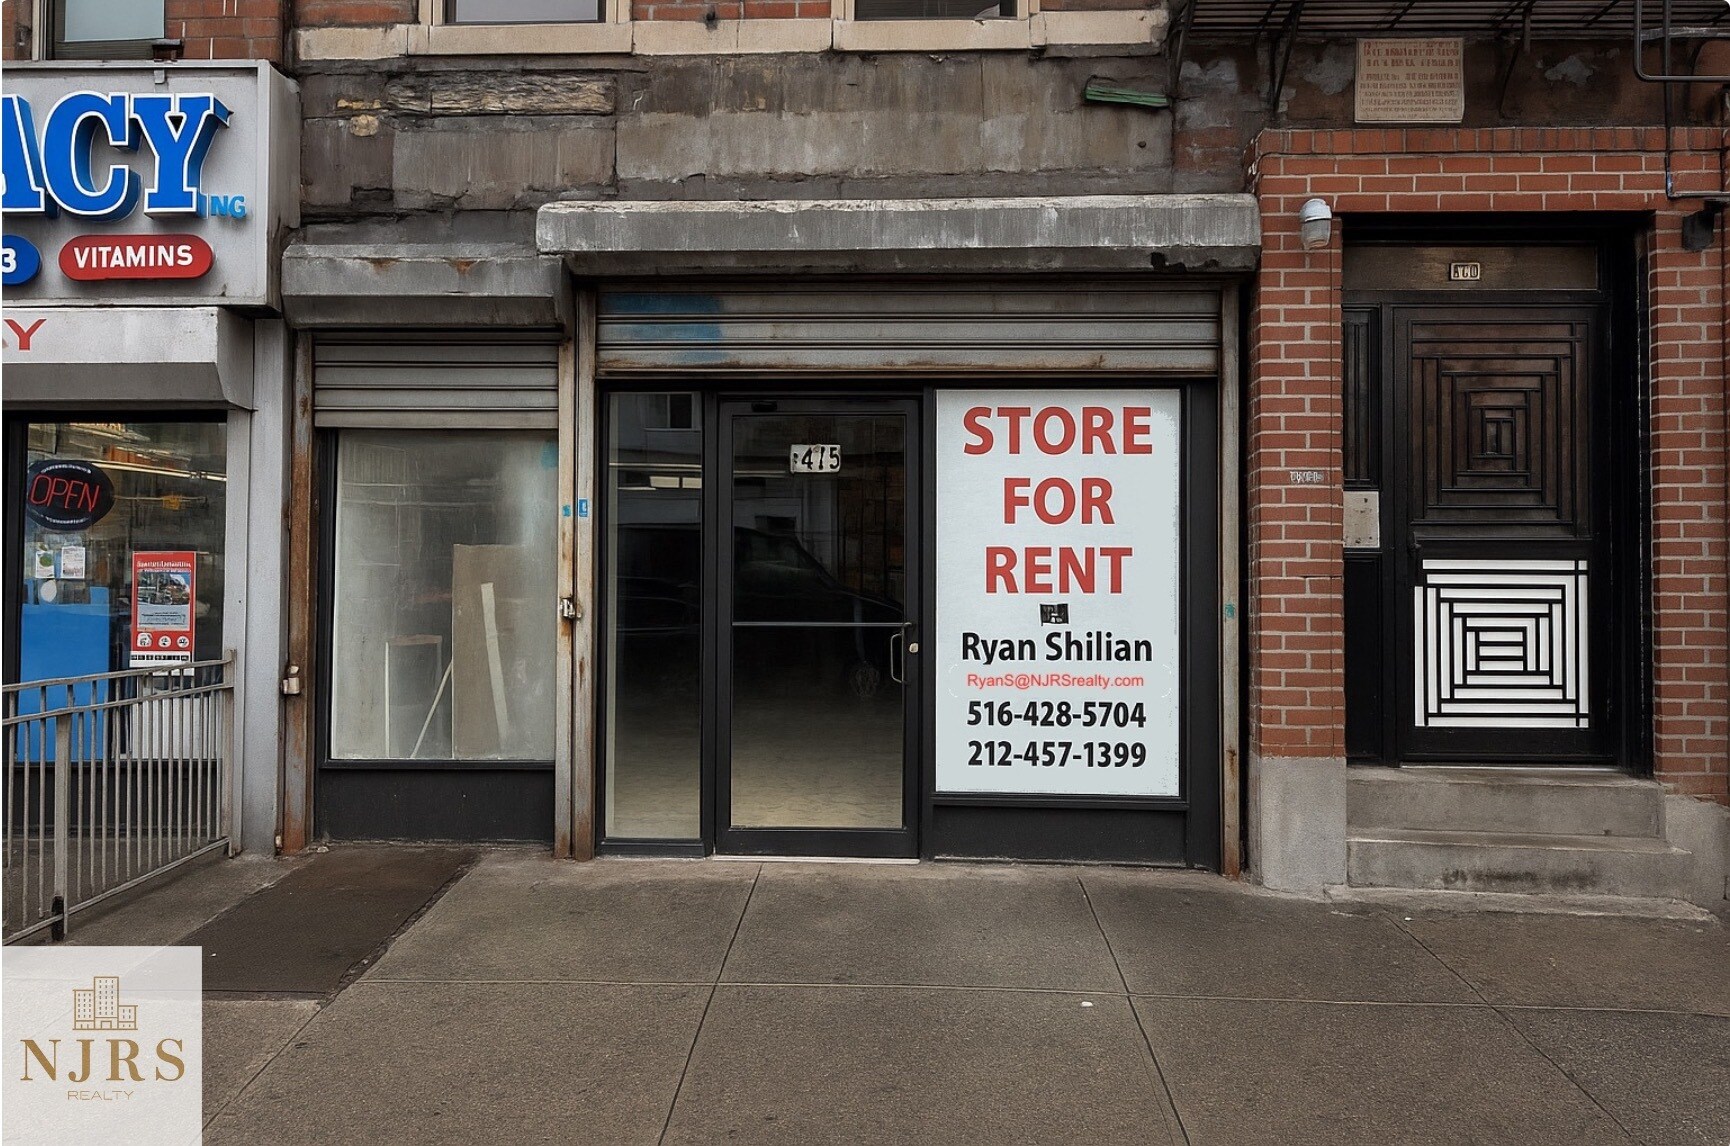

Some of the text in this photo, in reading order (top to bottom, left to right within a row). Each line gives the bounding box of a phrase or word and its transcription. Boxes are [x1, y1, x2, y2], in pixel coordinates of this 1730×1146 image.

[73, 244, 193, 269] VITAMINS
[2, 318, 47, 351] Y
[963, 407, 1152, 455] STORE
[30, 475, 99, 512] OPEN
[1004, 477, 1115, 525] FOR
[985, 546, 1132, 594] RENT
[962, 631, 1153, 666] Ryan Shilian
[967, 673, 1145, 691] RyanS@NJRSrealty.com
[966, 700, 1147, 728] 516-428-5704
[967, 740, 1147, 768] 212-457-1399
